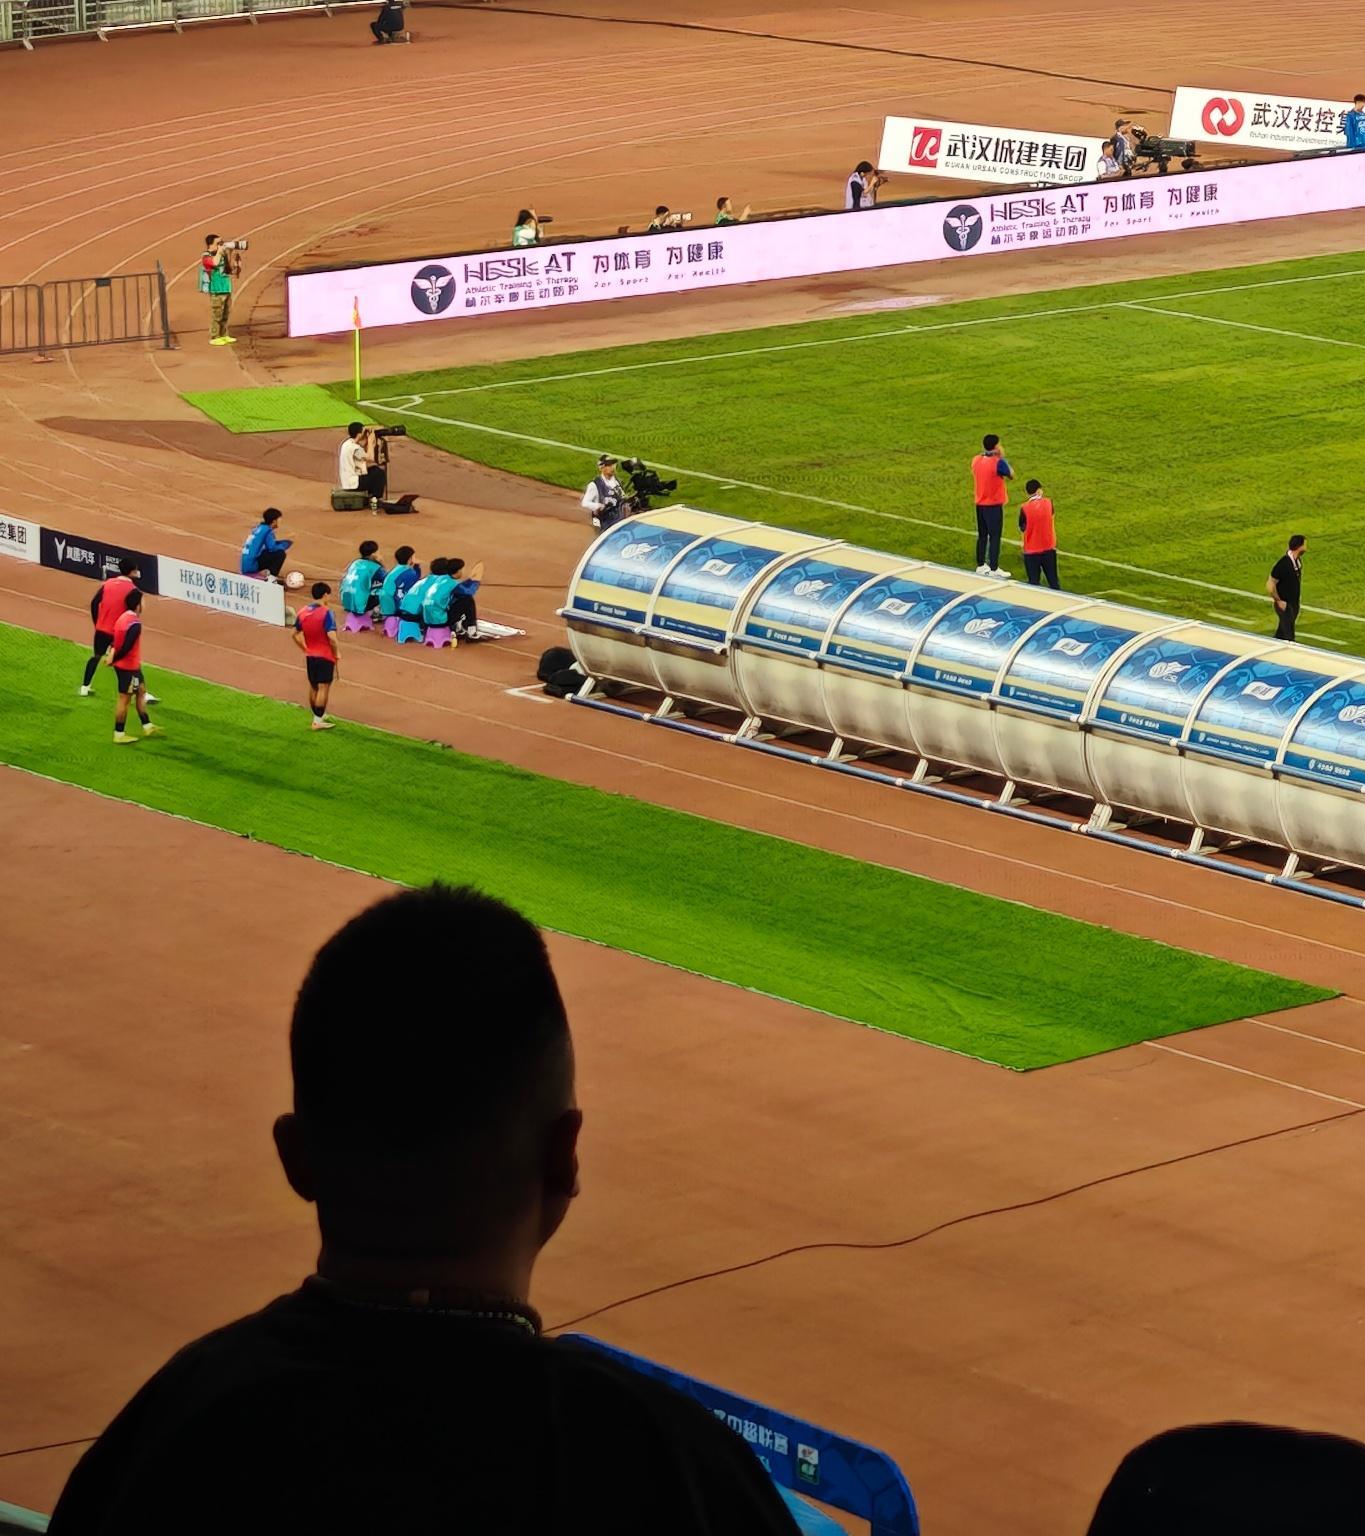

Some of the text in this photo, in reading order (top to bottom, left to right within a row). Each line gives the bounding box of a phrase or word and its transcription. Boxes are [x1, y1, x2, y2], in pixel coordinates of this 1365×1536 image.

[946, 133, 1087, 172] 武汉城建集团
[1103, 183, 1218, 214] 为体育 为健康
[593, 241, 723, 274] 为体育 为健康
